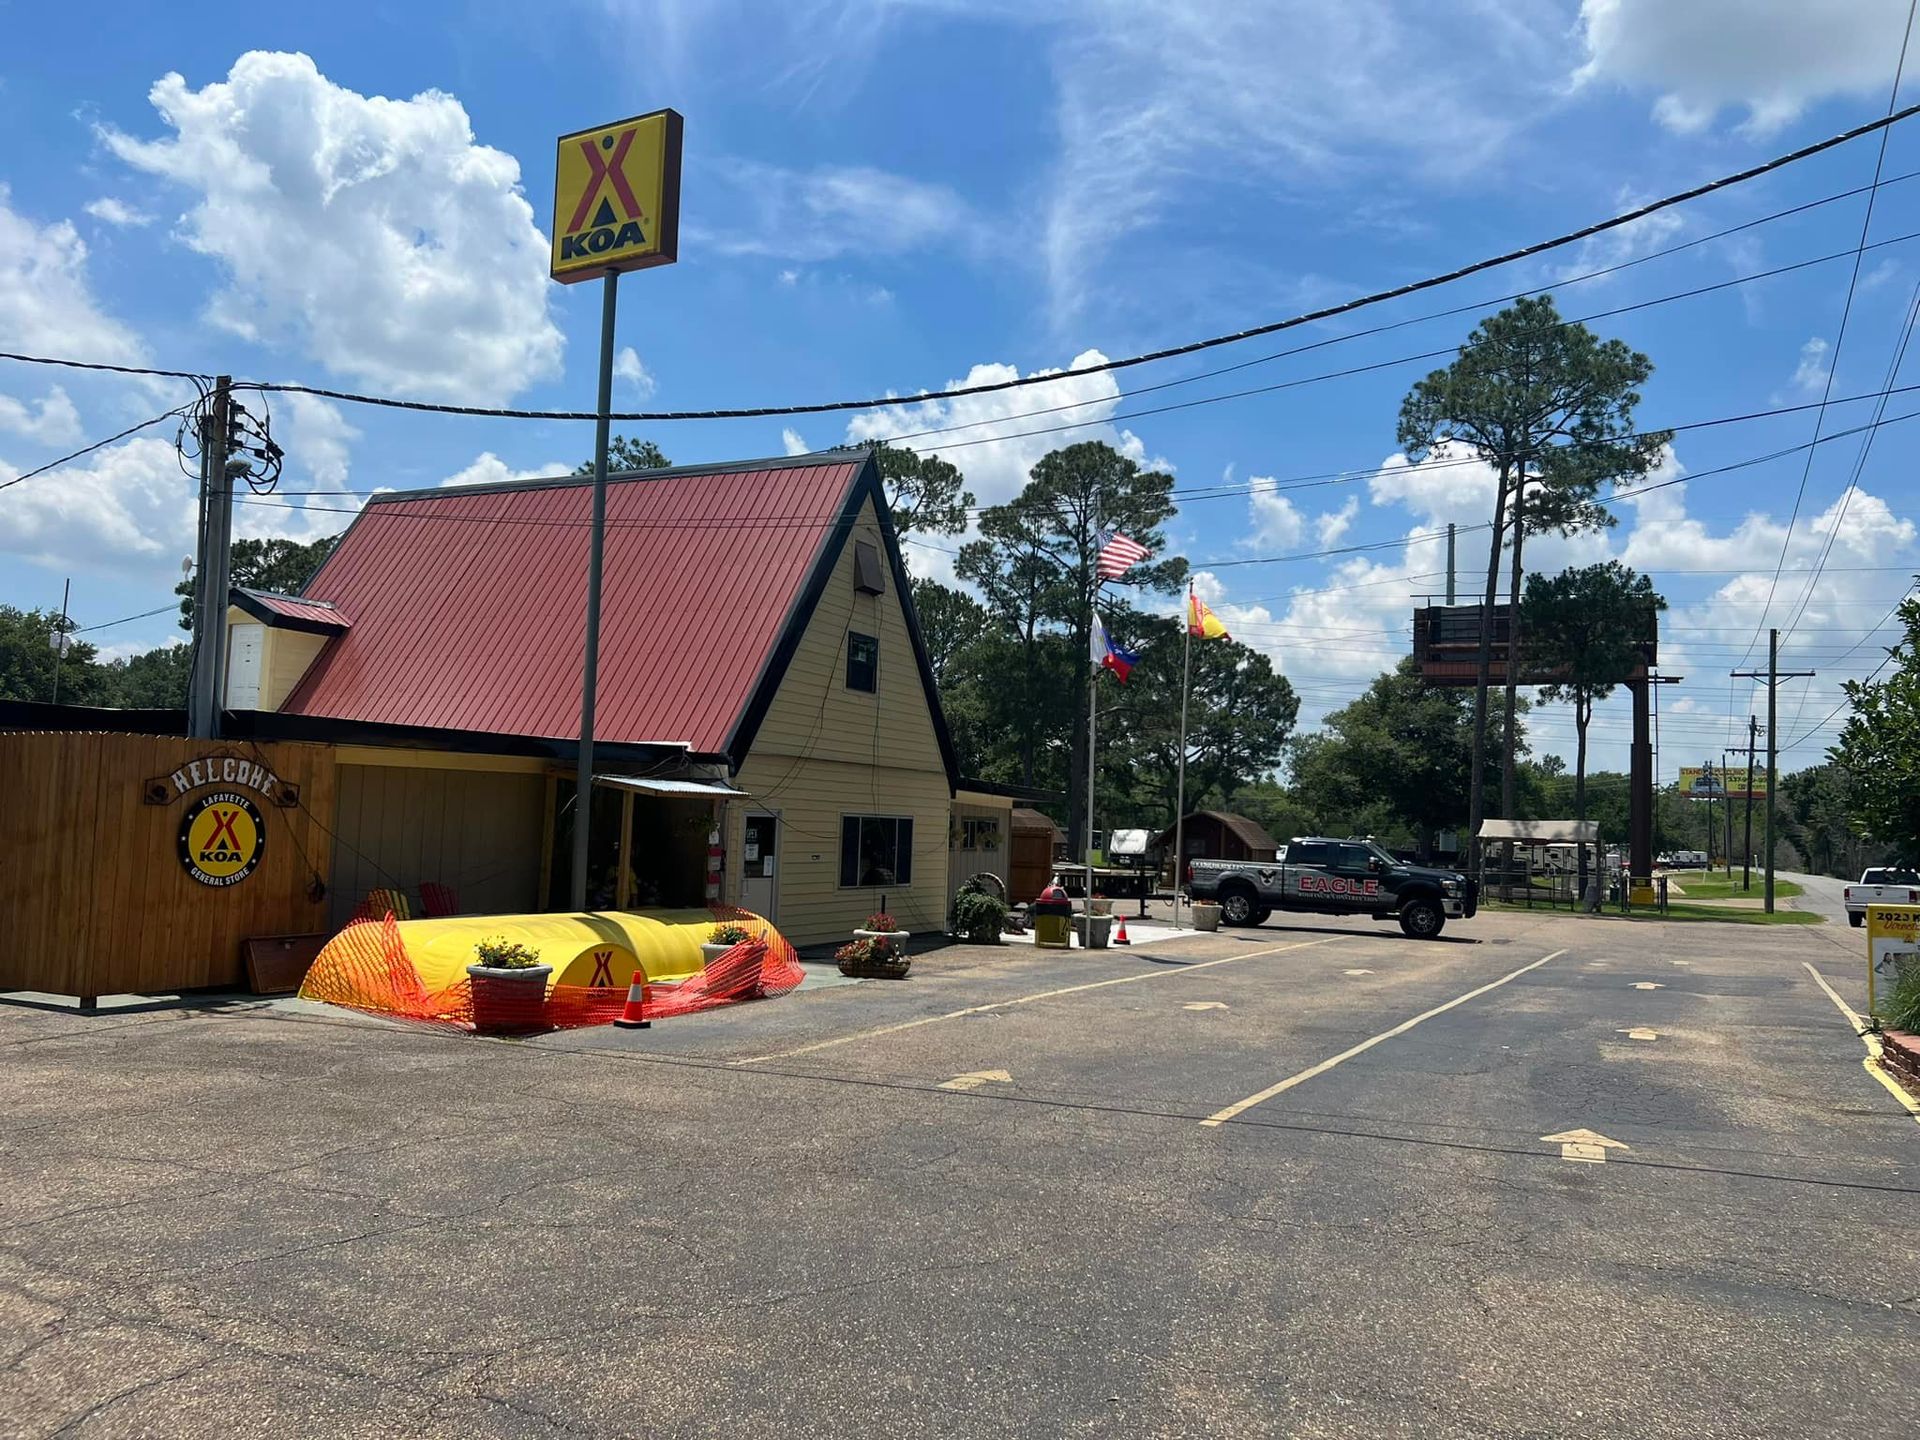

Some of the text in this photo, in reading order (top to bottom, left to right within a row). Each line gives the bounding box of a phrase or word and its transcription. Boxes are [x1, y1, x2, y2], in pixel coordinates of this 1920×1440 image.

[561, 221, 645, 260] KOA
[170, 758, 278, 797] WELCOME
[202, 793, 250, 810] LAFAYETTE
[199, 851, 242, 863] KOA
[190, 867, 250, 886] GENERAL STORE
[1298, 876, 1379, 896] EAGLE
[1876, 913, 1910, 921] 2023
